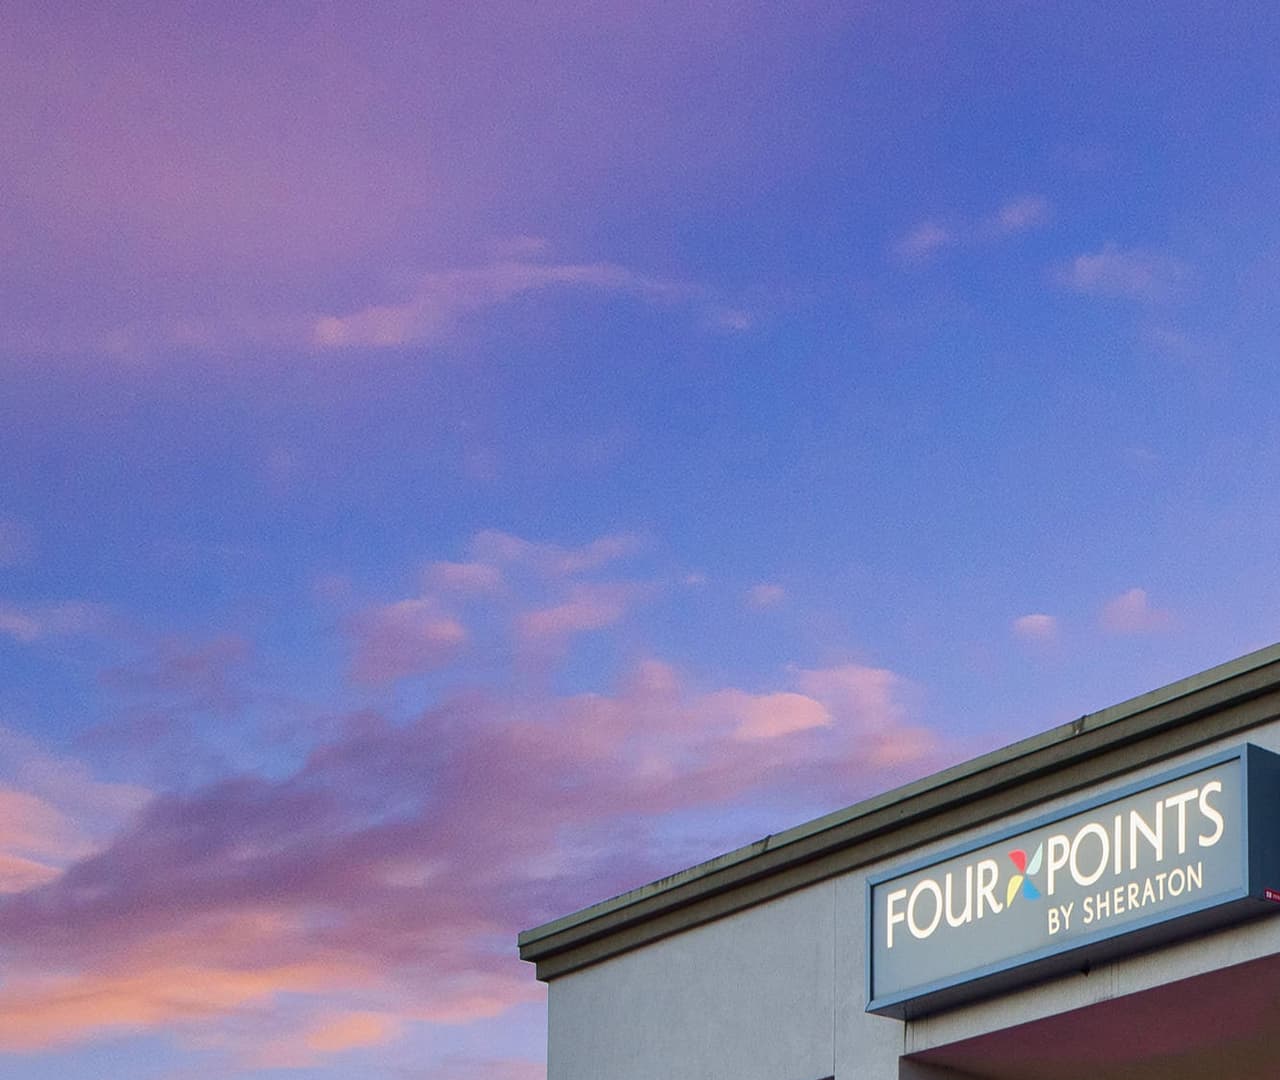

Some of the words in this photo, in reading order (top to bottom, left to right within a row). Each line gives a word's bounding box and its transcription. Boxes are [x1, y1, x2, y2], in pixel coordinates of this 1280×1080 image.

[887, 859, 1003, 948] FOUR
[1047, 781, 1225, 896] POINTS
[1048, 902, 1075, 936] BY
[1083, 862, 1203, 924] SHERATON
